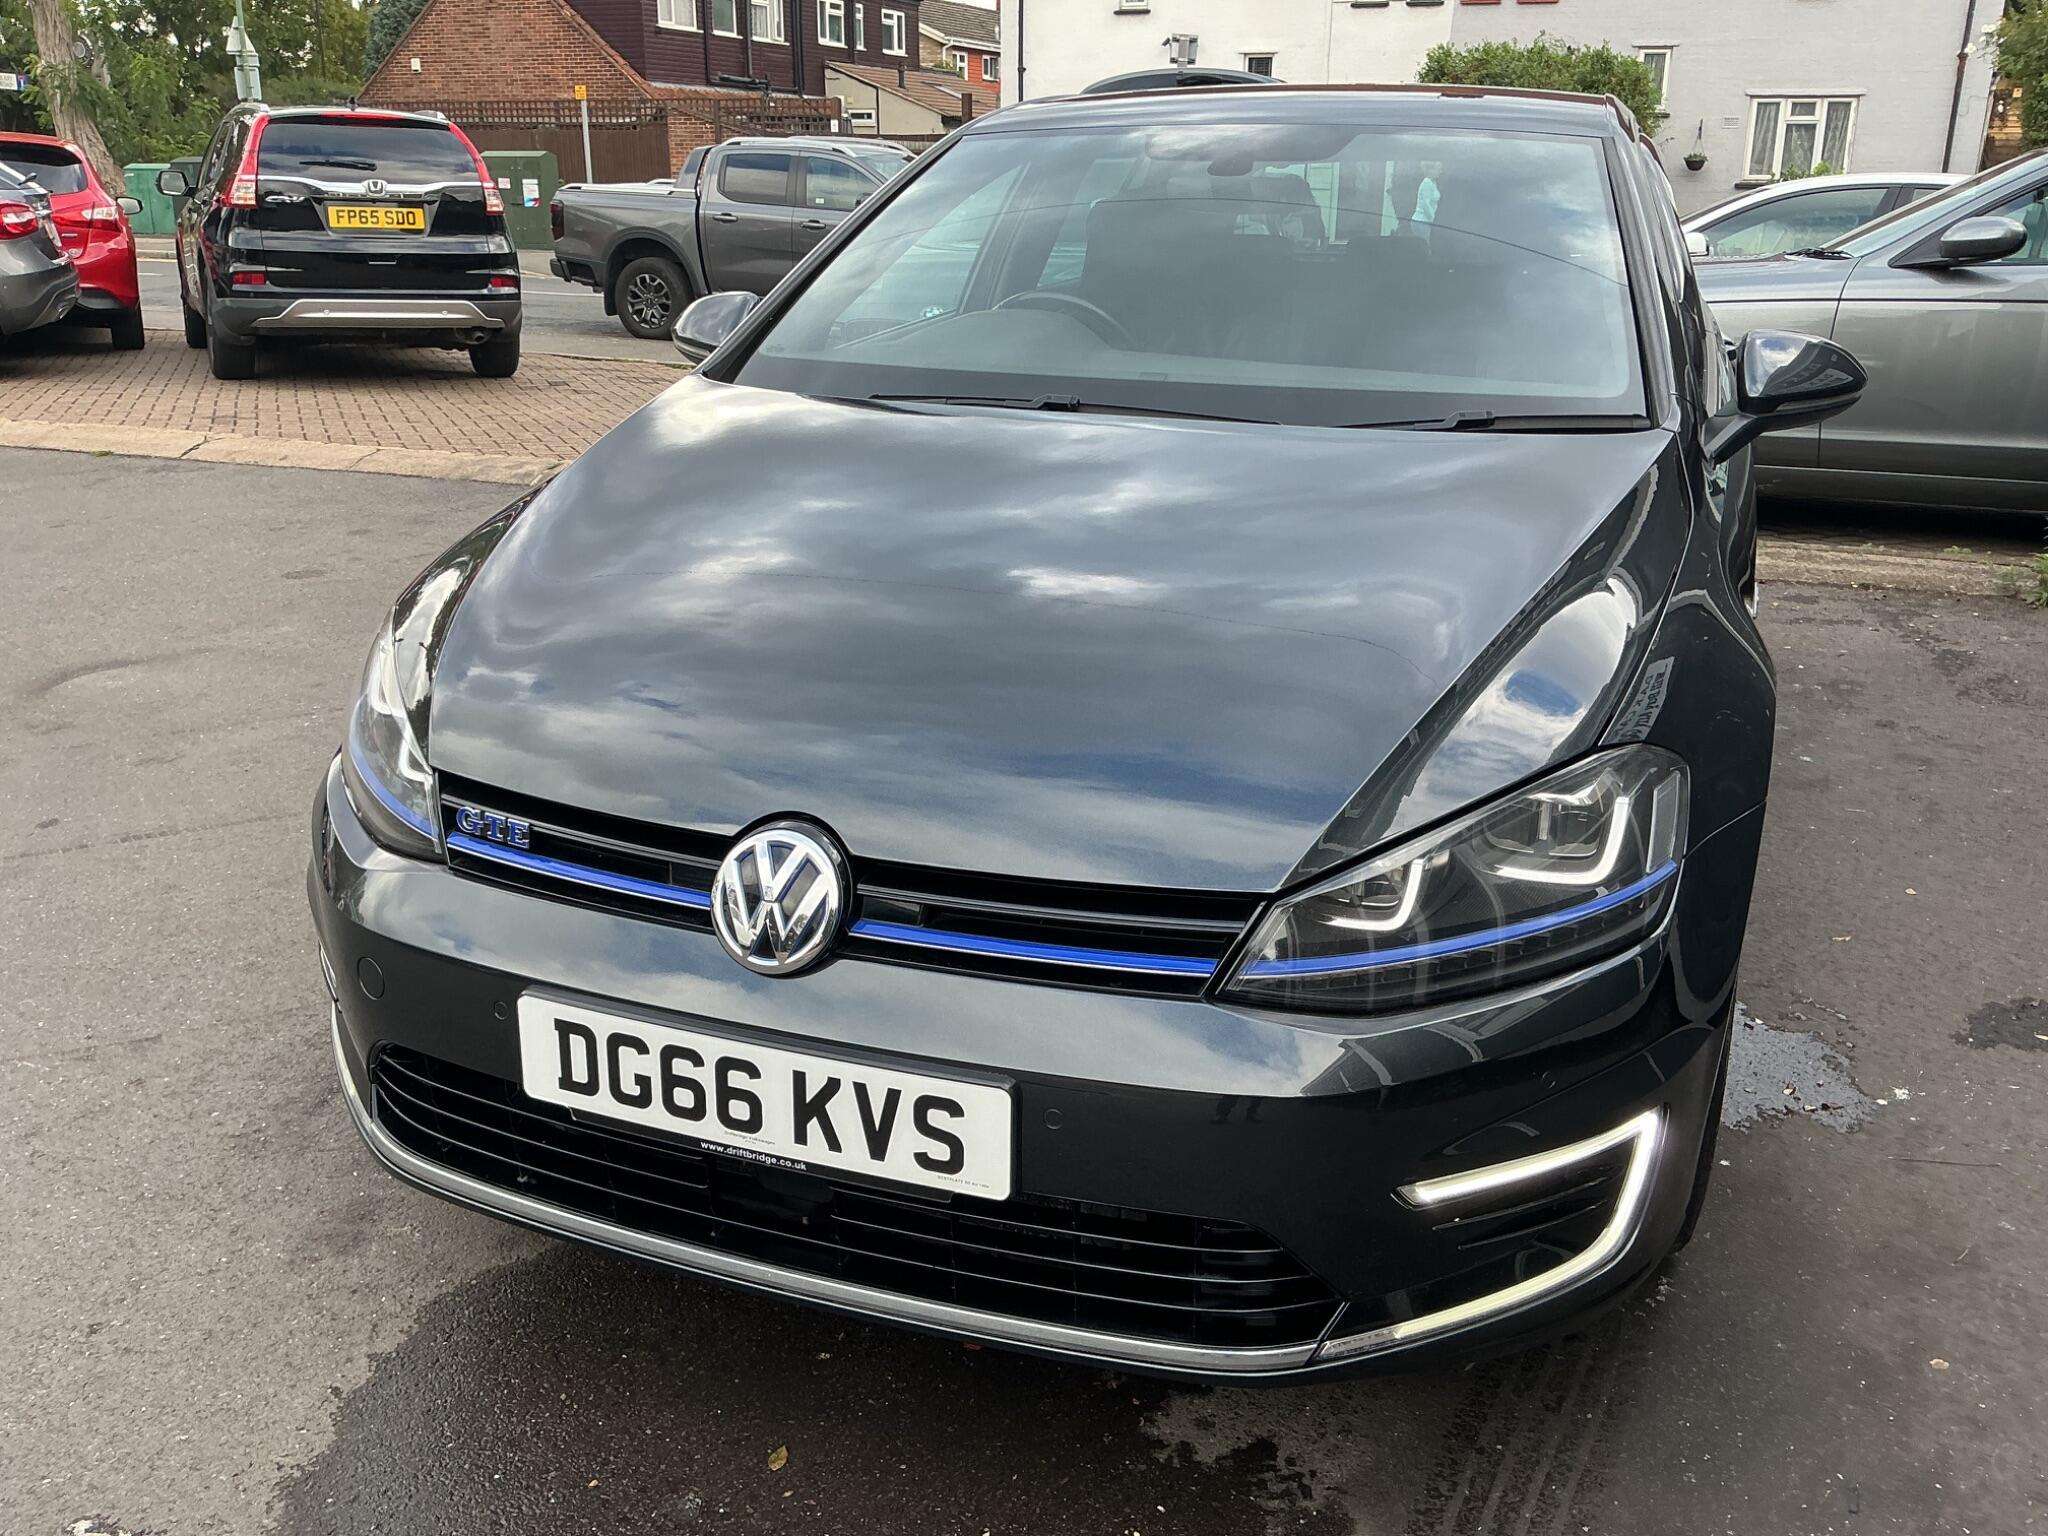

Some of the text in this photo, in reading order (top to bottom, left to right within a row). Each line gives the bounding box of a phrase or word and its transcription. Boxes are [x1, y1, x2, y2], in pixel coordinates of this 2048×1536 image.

[336, 209, 417, 226] FP65 SDO
[456, 806, 531, 850] GTE
[553, 1017, 965, 1175] DG66 KVS
[700, 1141, 807, 1171] www.driftbridge.co.uk
